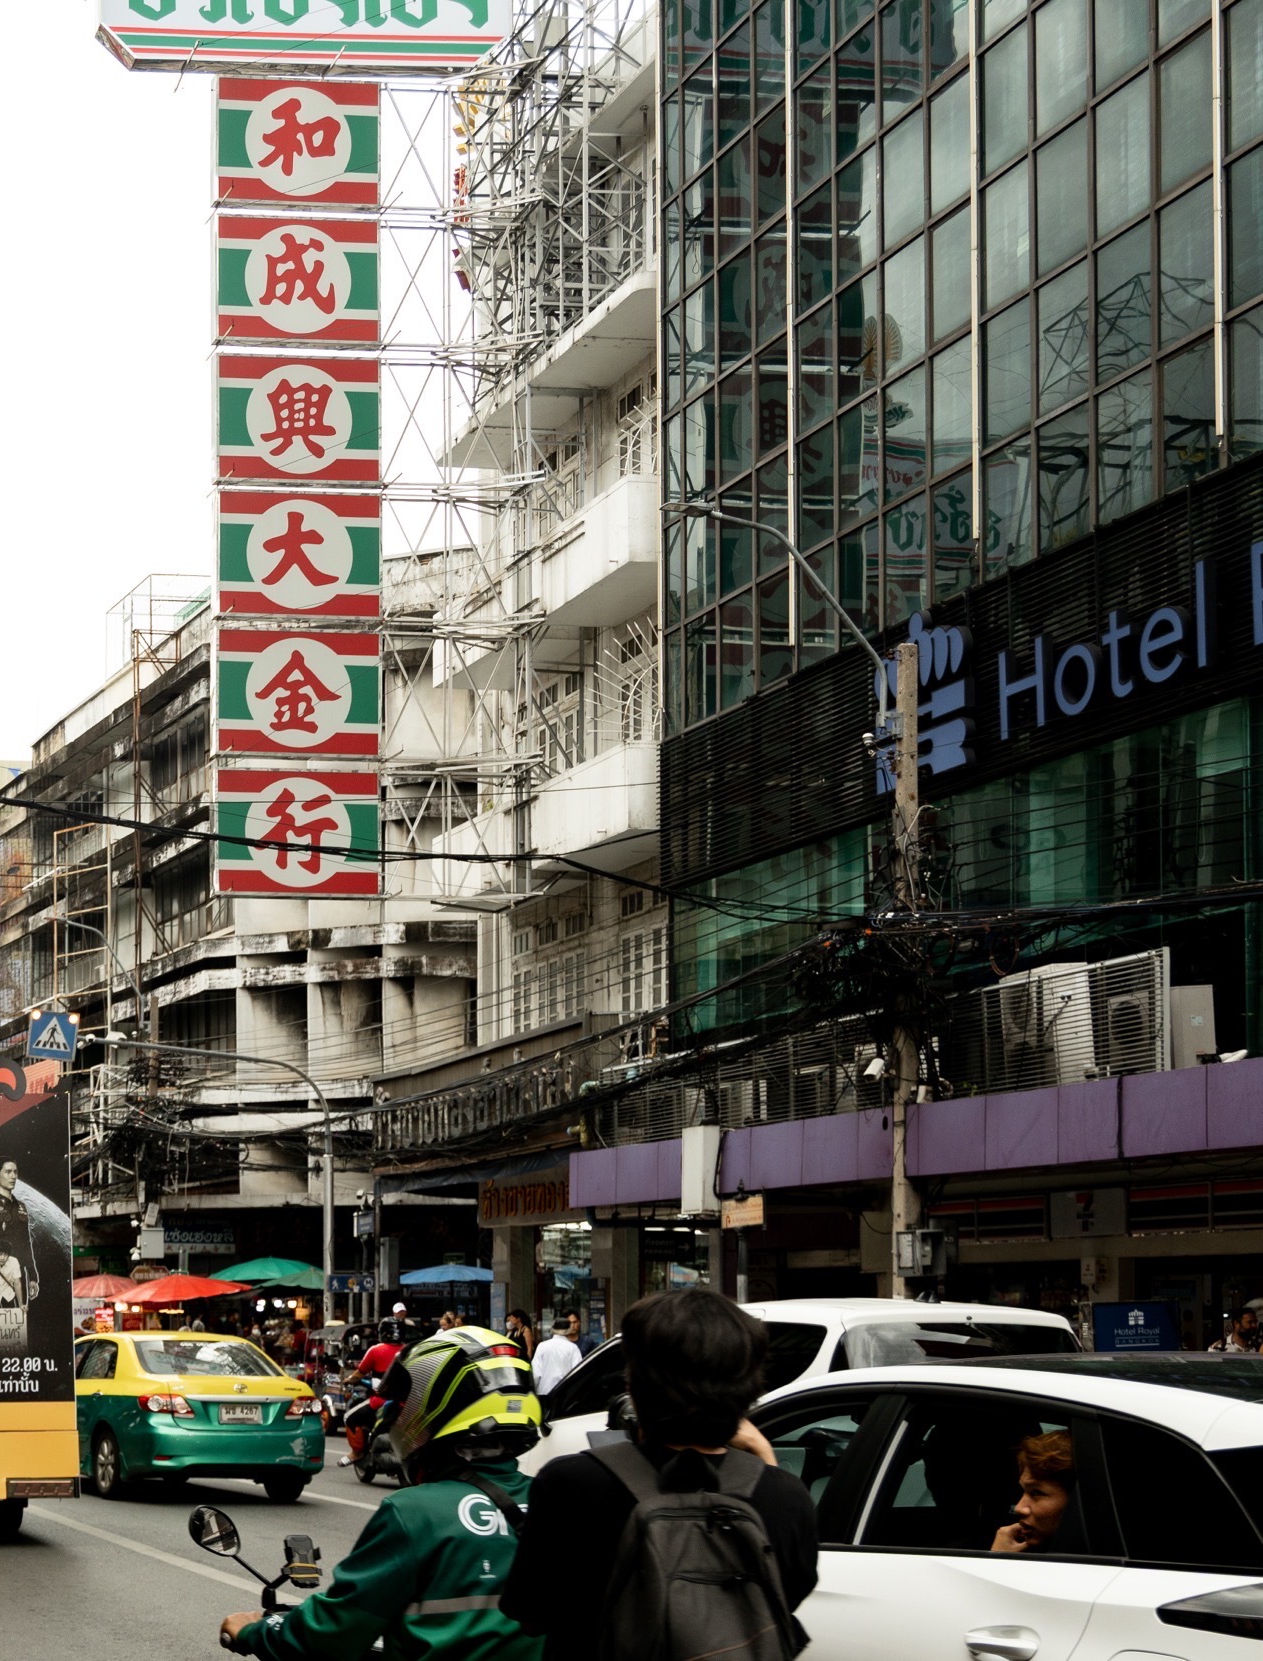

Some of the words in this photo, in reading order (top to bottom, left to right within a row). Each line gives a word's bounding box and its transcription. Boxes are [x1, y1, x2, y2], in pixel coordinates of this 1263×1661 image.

[998, 560, 1207, 741] Hotel
[1138, 1327, 1159, 1335] Royal
[2, 1357, 41, 1373] 22.00
[44, 1359, 58, 1372] น.
